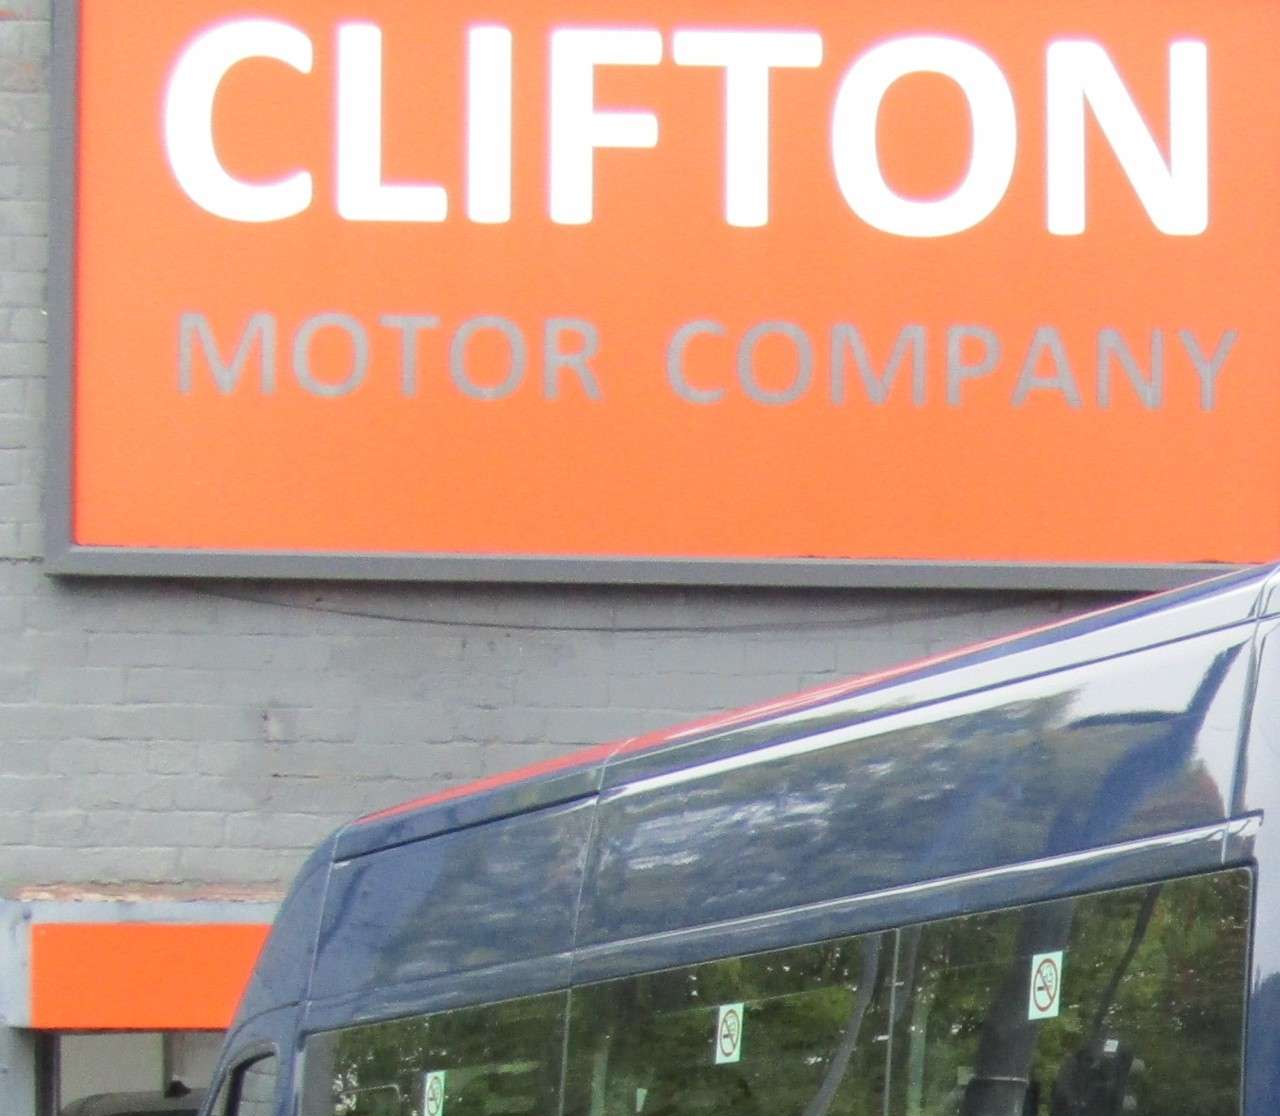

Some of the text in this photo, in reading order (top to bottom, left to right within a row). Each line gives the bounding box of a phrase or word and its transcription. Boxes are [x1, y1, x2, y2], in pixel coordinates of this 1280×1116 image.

[162, 18, 1210, 238] CLIFTON
[174, 311, 1240, 413] MOTOR COMPANY
